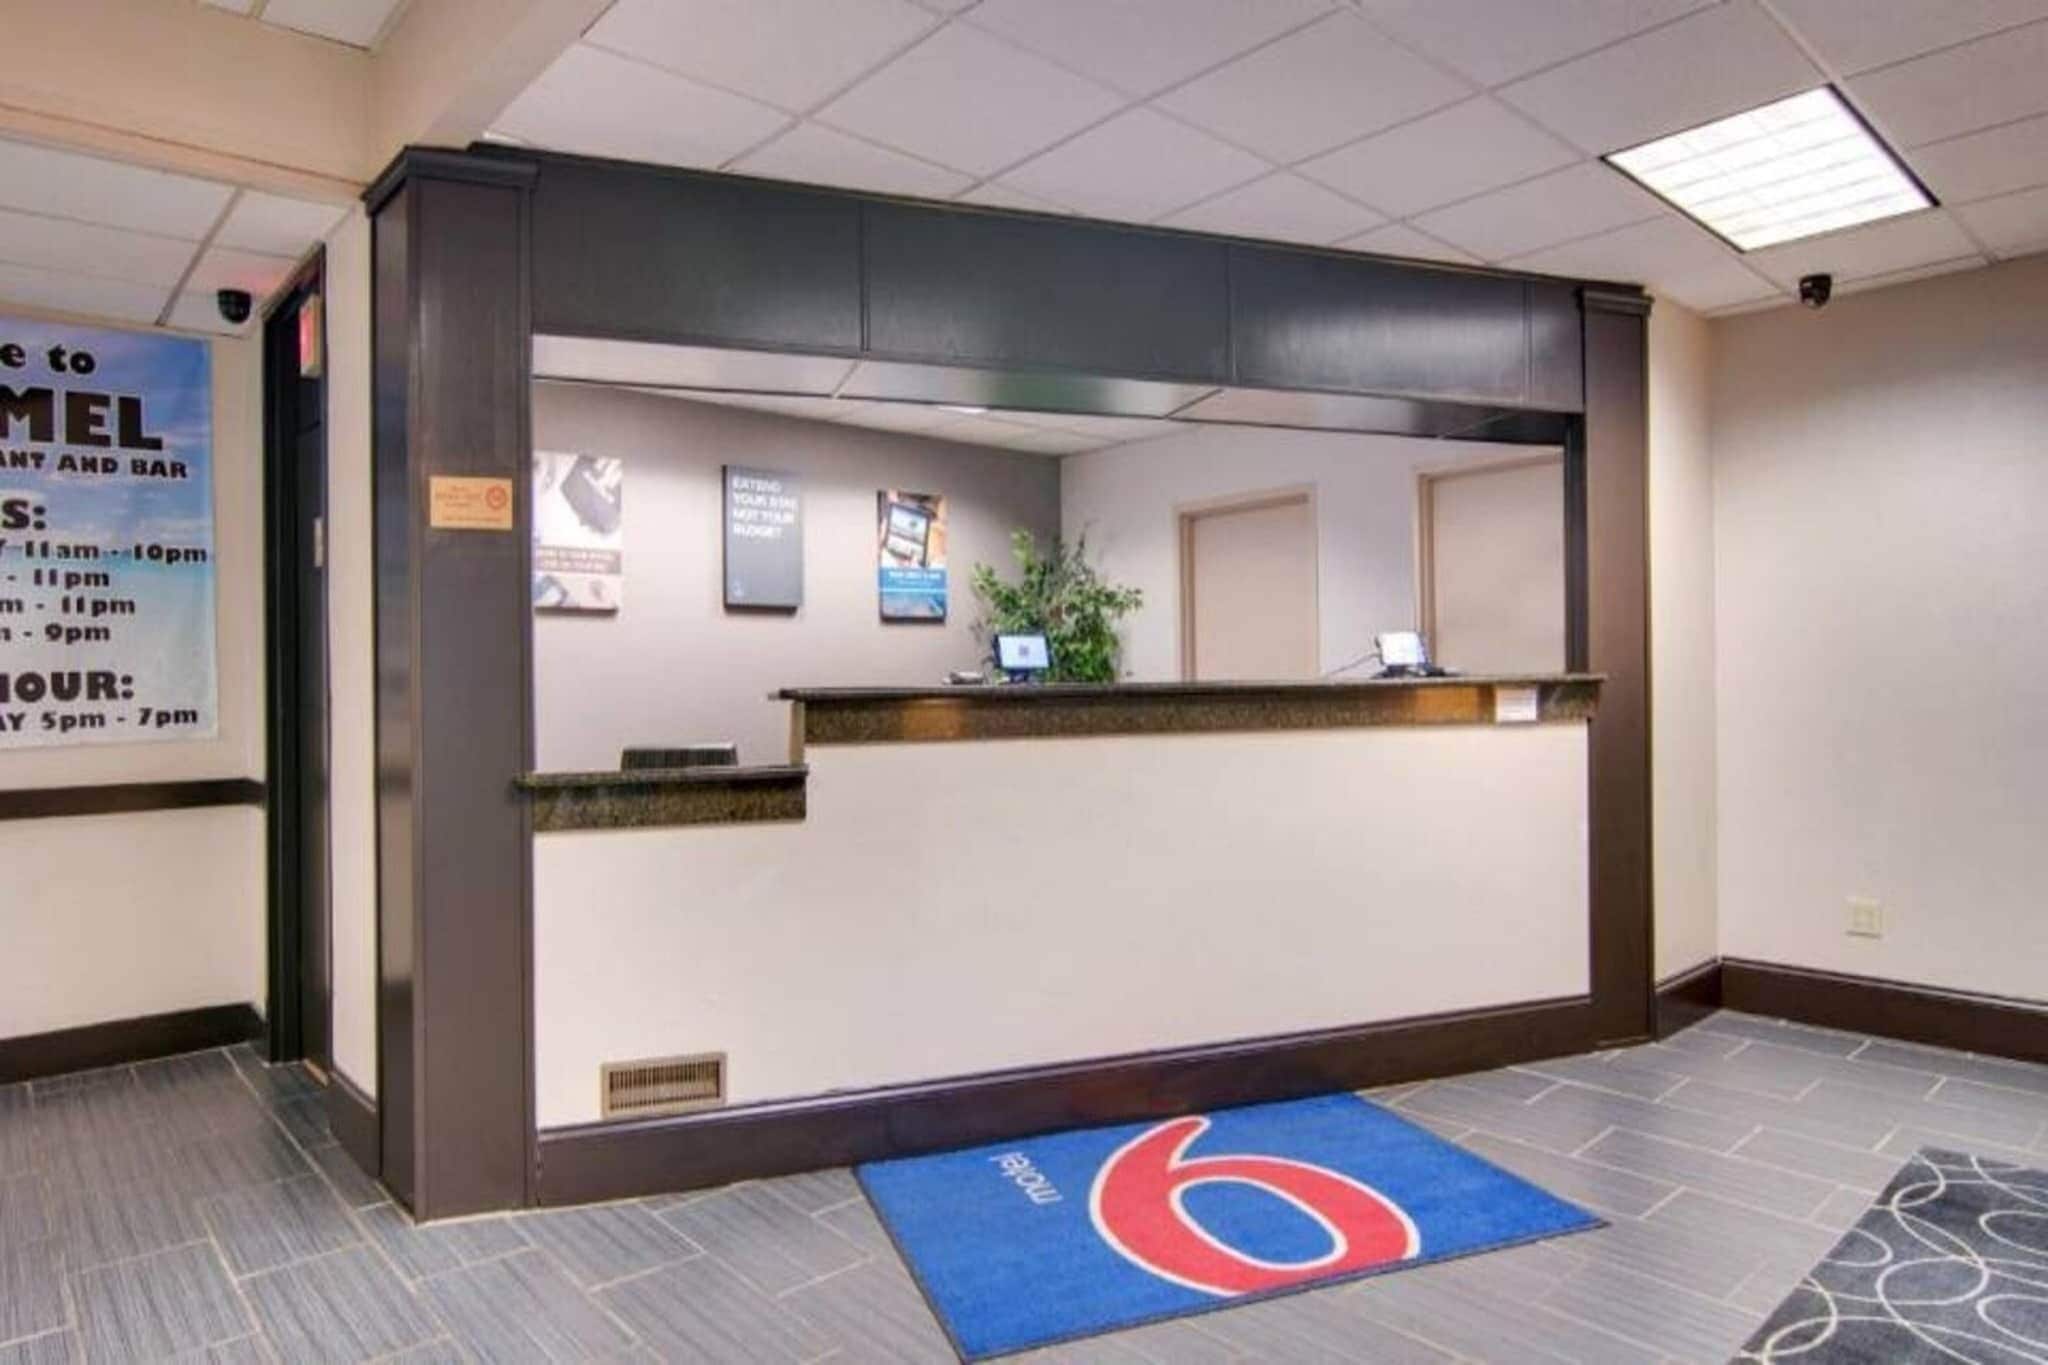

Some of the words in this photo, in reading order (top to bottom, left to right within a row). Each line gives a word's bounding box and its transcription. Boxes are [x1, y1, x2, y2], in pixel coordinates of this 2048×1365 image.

[48, 345, 96, 374] to
[0, 384, 163, 451] MEL
[57, 455, 118, 474] AND
[131, 458, 187, 478] BAR
[733, 476, 781, 493] EXTEND
[733, 492, 768, 509] YOUR
[1, 498, 46, 530] S:
[25, 540, 99, 559] 11am
[134, 544, 207, 564] 10pm
[34, 568, 109, 589] 11pm
[61, 596, 135, 616] 11pm
[45, 623, 110, 644] 9pm
[41, 711, 105, 732] 5pm
[138, 707, 198, 728] 7pm
[1089, 1115, 1420, 1296] 6
